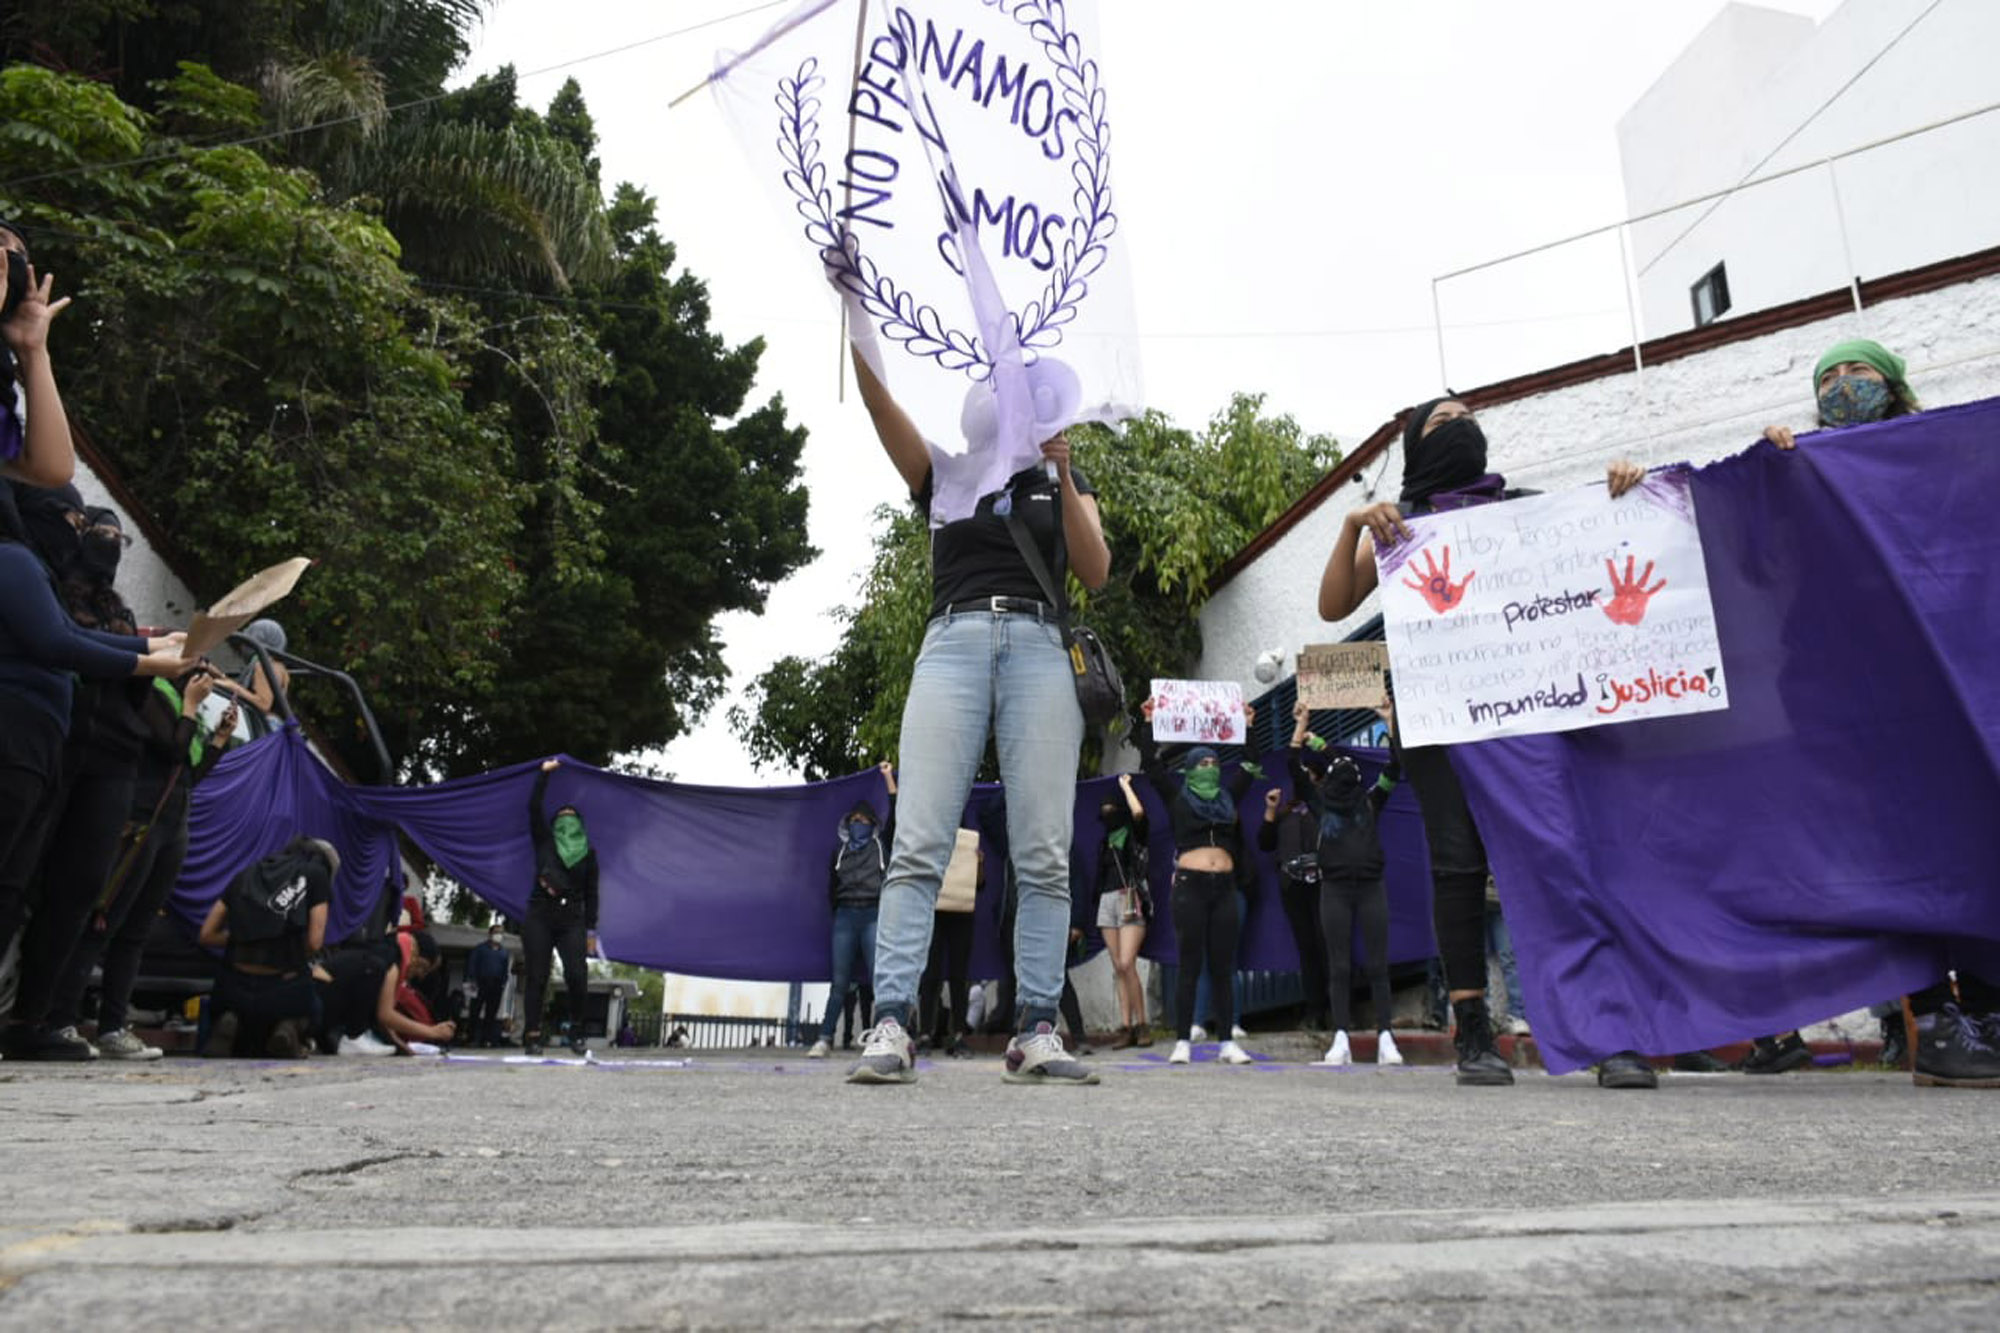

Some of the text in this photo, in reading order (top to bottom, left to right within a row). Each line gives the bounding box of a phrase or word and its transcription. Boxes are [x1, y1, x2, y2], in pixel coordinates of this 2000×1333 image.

[836, 7, 1077, 229] NO PENAMOS
[1455, 521, 1505, 566] Hoy
[1502, 588, 1602, 632] protestar
[1465, 673, 1588, 726] impunidad
